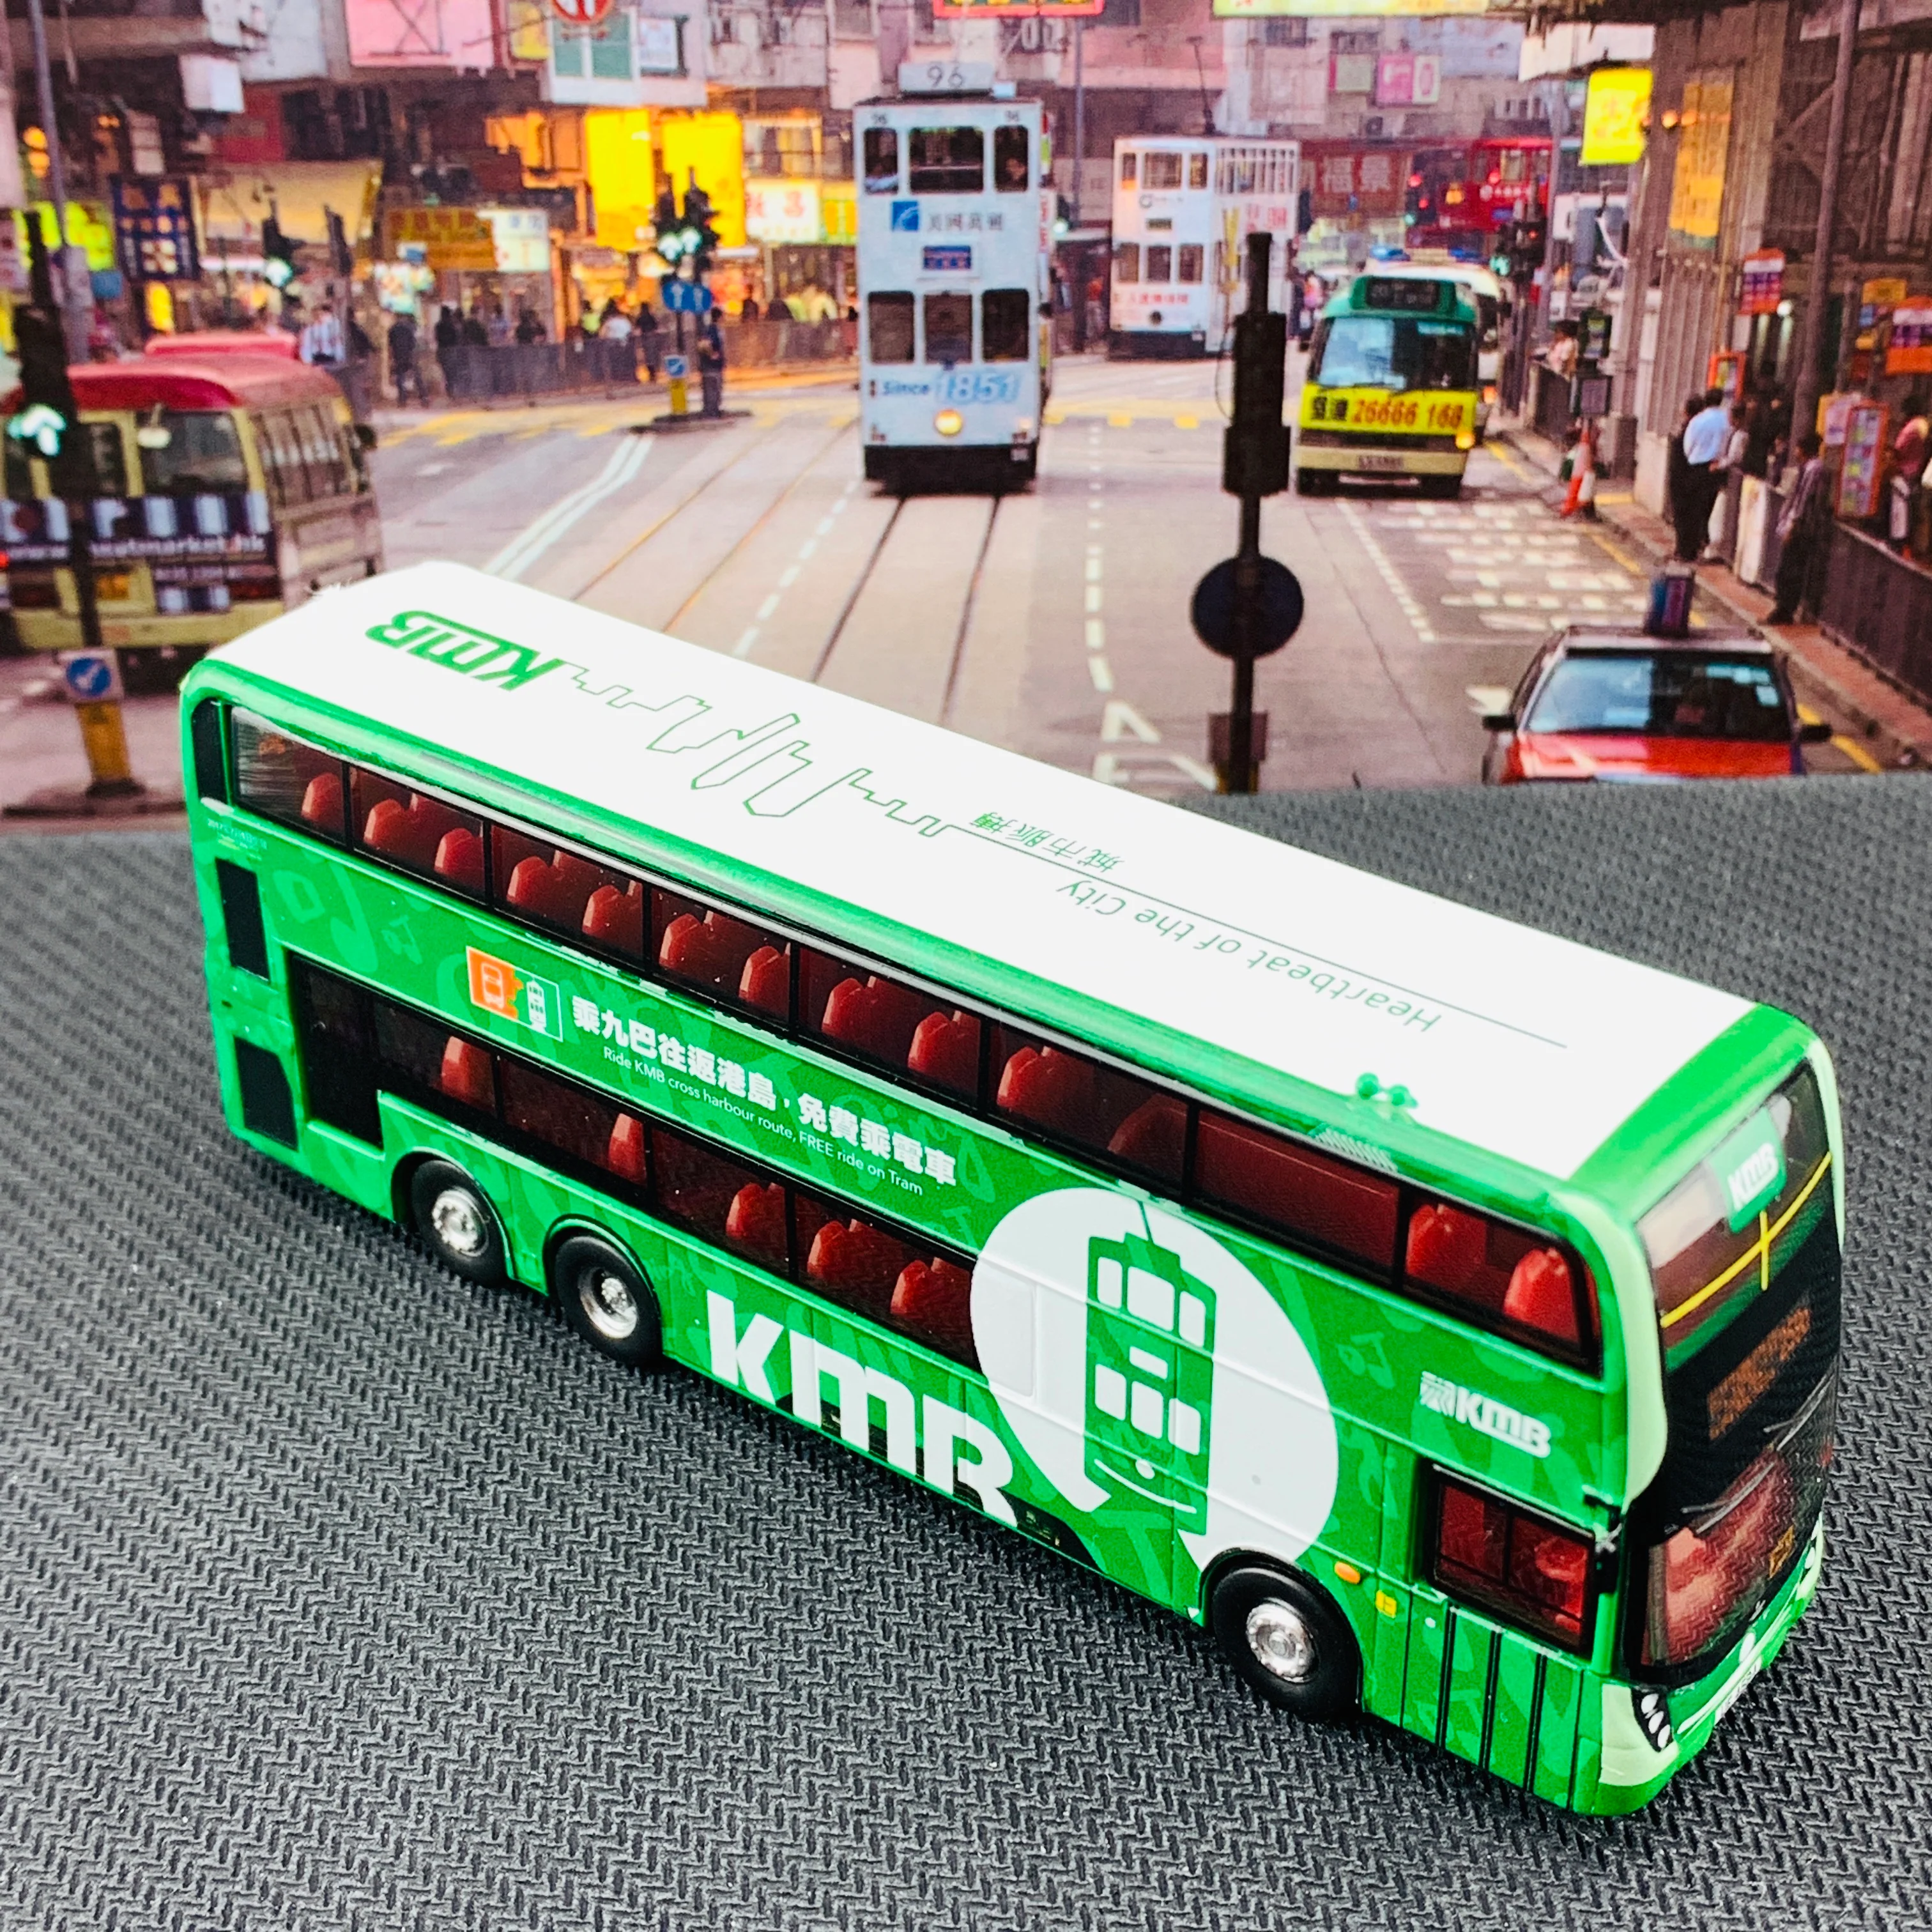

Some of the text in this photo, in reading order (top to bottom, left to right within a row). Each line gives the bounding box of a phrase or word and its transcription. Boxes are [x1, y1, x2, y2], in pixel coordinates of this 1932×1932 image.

[927, 65, 964, 89] 96
[883, 369, 1022, 406] Since 1851
[364, 610, 565, 691] KMB
[969, 811, 1125, 873] 城市脈搏
[1055, 880, 1442, 1032] Heartbeat of the City
[603, 1045, 923, 1197] Ride KMB cross harbour route, FREE ride on Tram
